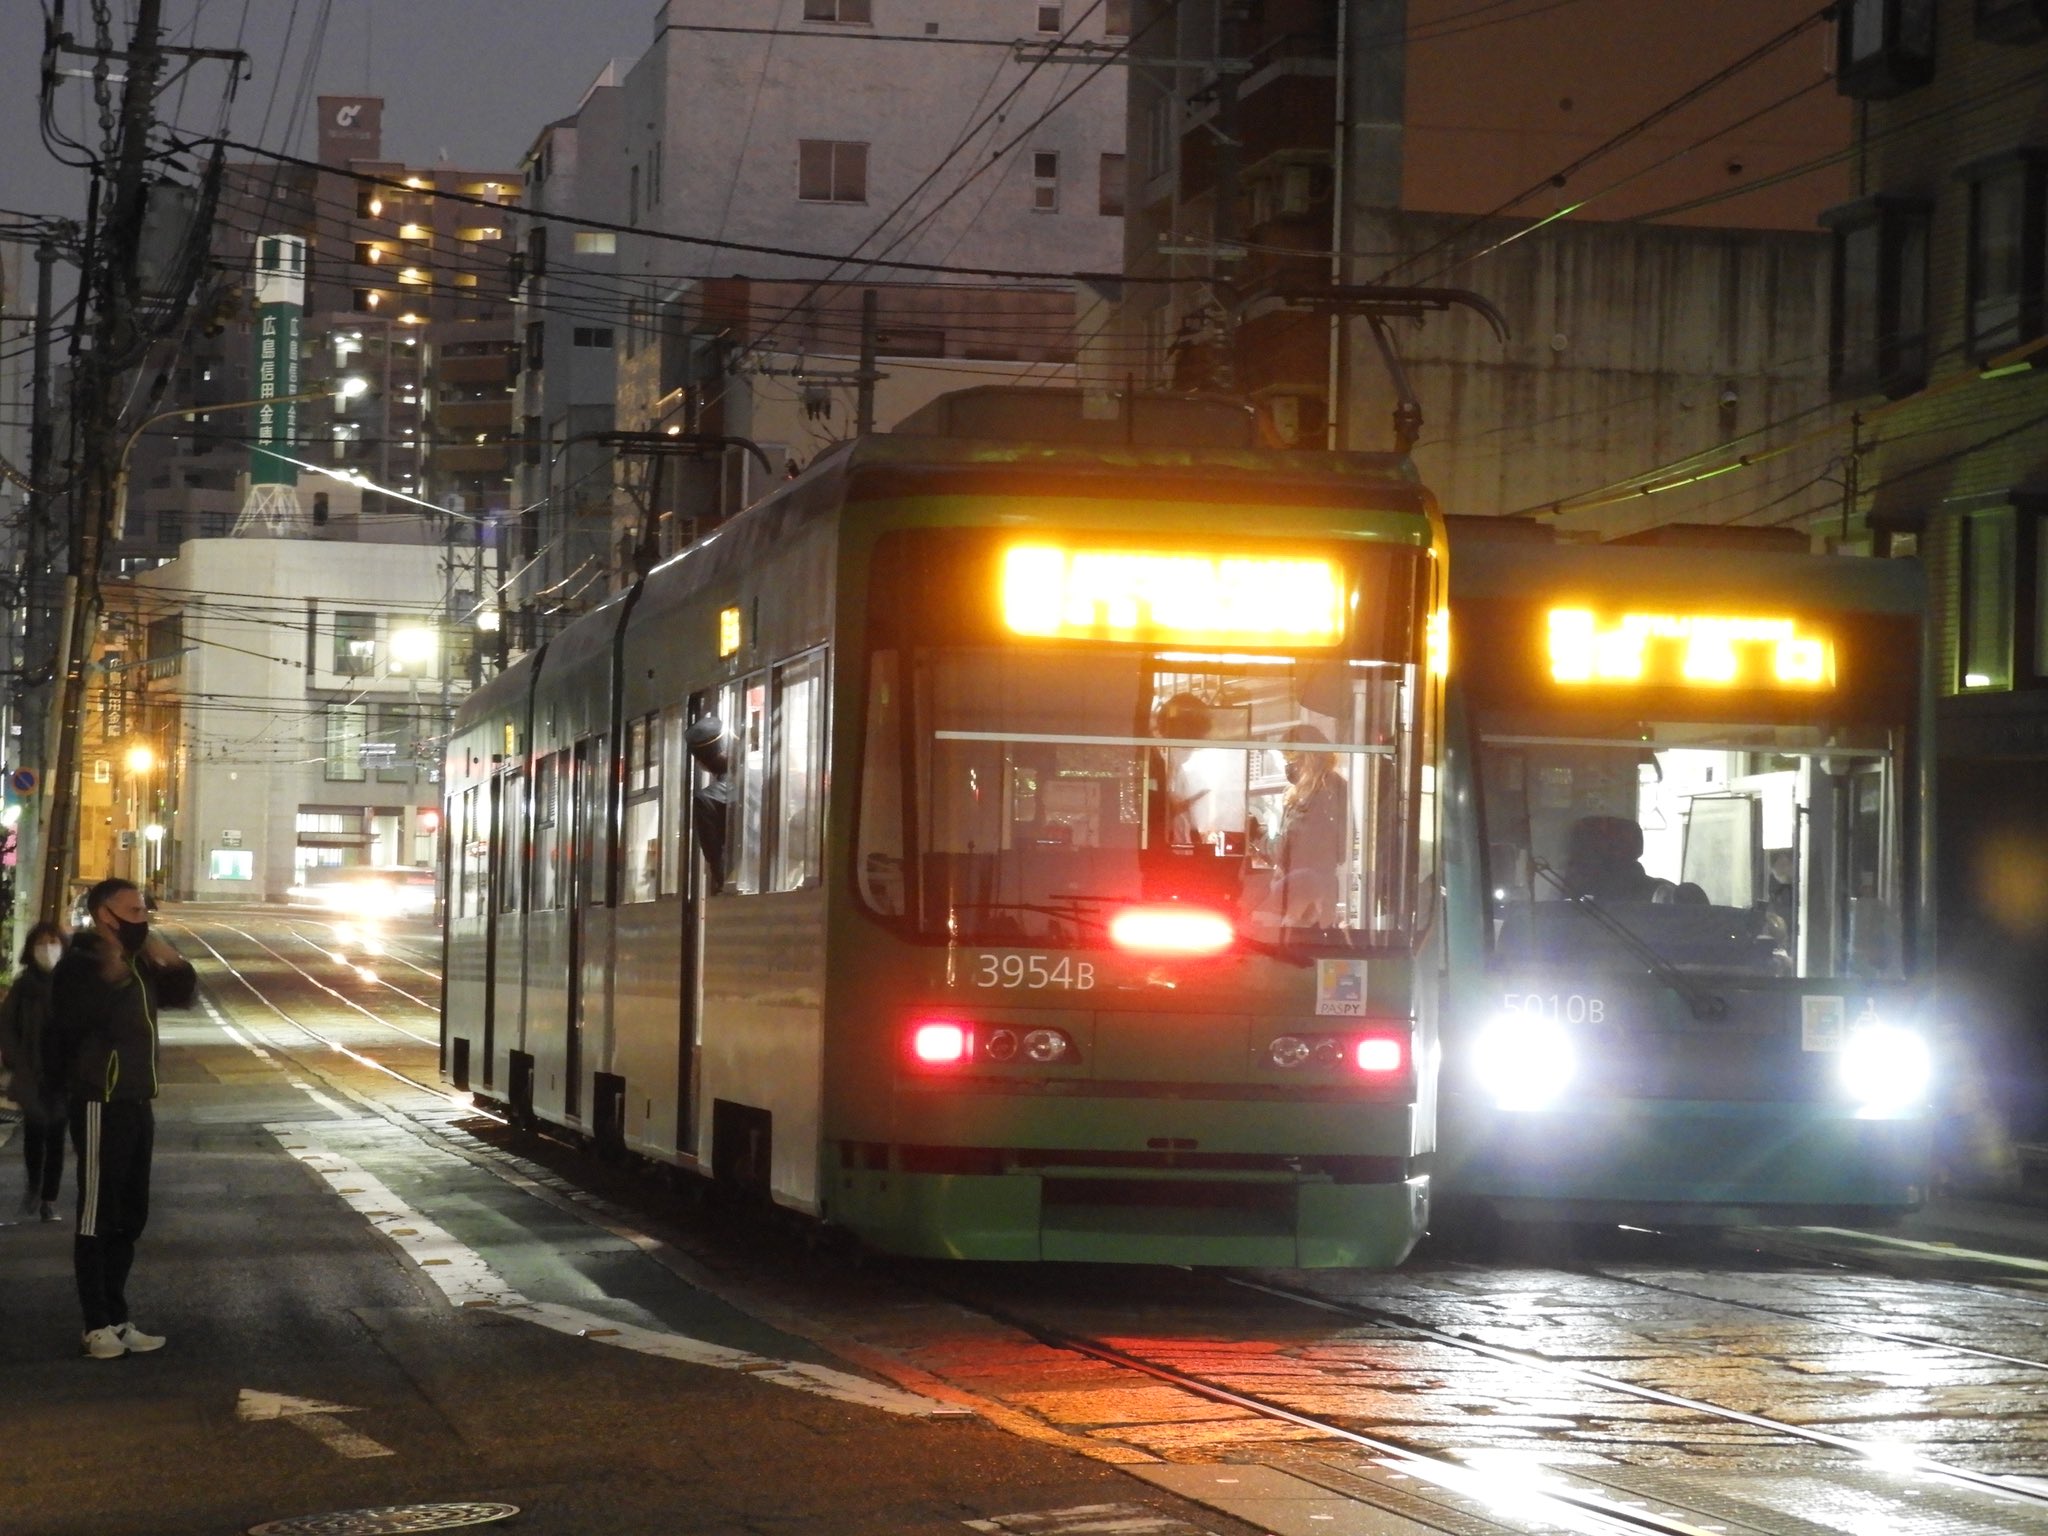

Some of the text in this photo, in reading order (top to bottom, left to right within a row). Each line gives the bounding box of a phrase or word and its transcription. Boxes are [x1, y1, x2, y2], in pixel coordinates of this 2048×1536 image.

[258, 314, 277, 446] 広島信用金庫
[977, 954, 1095, 990] 3954B
[1503, 993, 1605, 1024] 5010B
